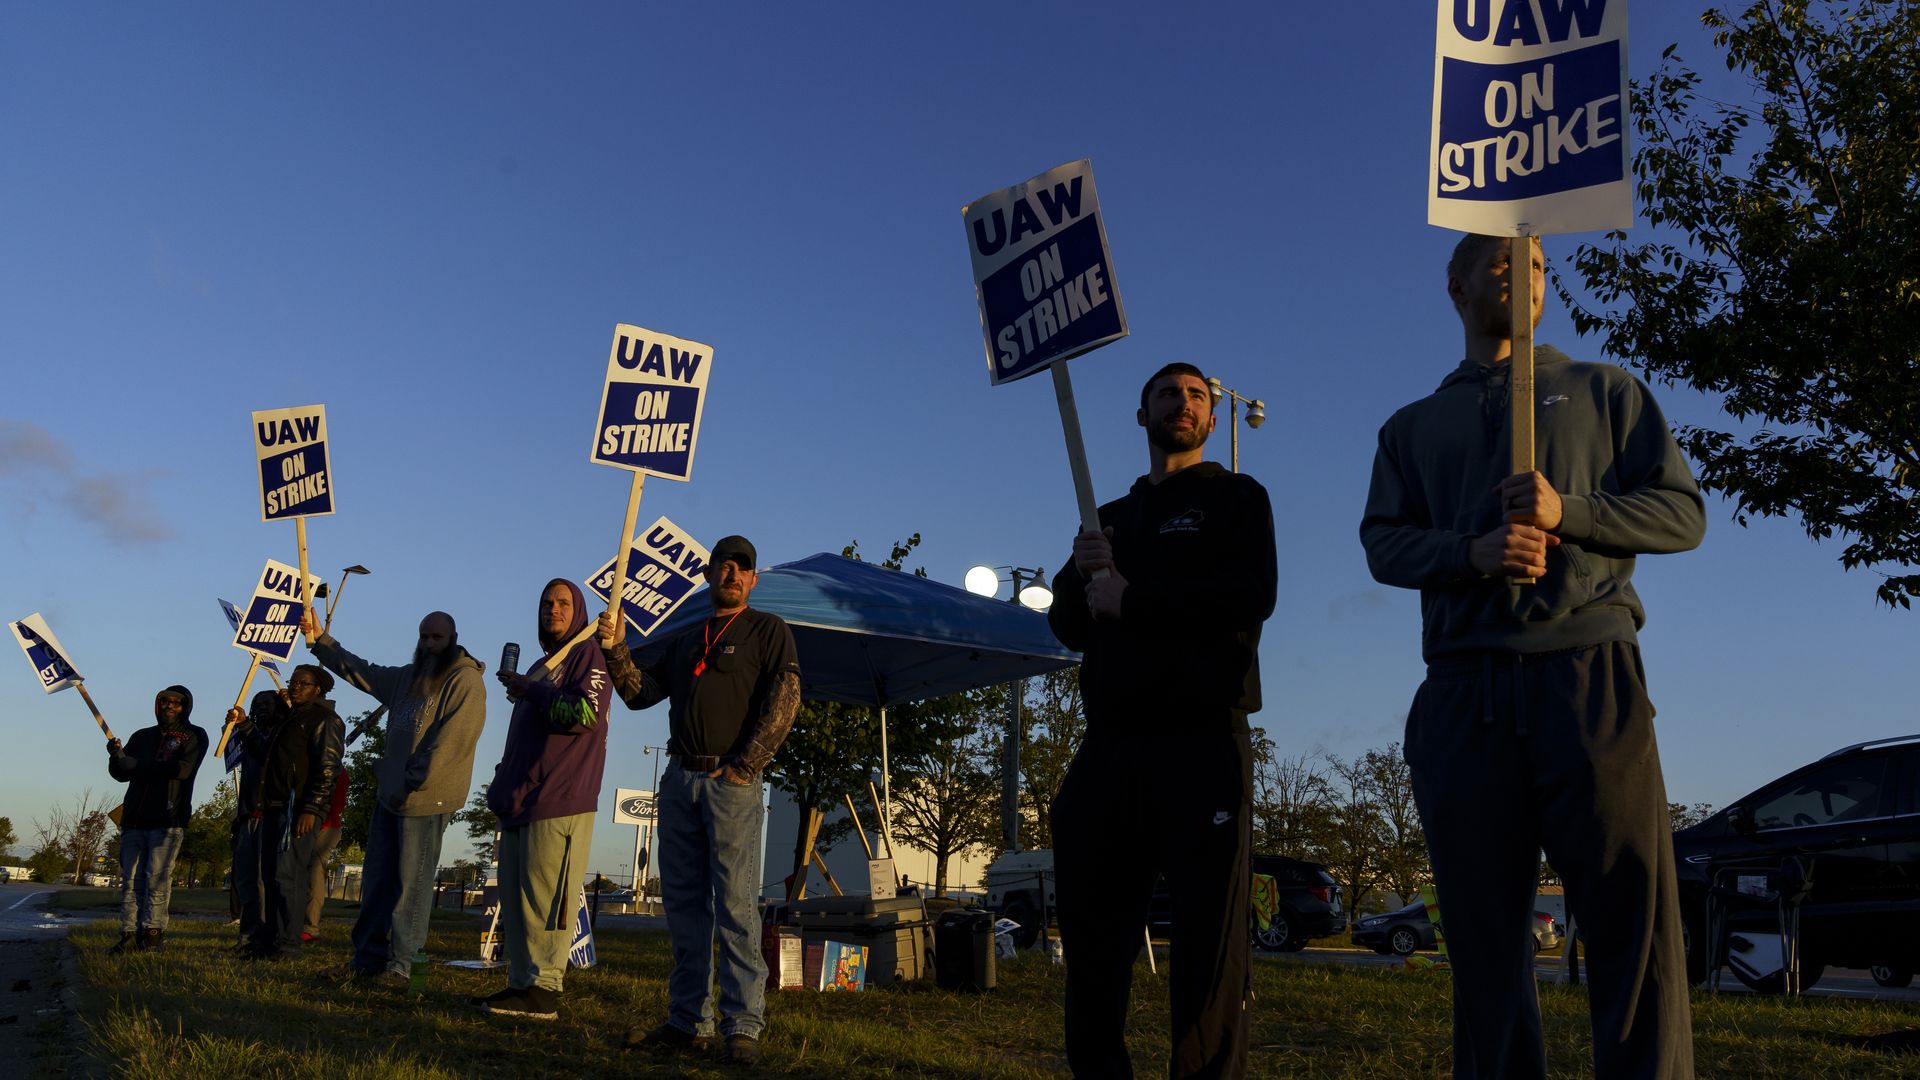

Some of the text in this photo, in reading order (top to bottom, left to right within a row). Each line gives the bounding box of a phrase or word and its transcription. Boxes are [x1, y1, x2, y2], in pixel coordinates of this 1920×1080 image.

[1453, 0, 1606, 46] UAW
[1484, 63, 1554, 128] ON
[1440, 94, 1620, 192] STRIKE
[973, 175, 1083, 257] UAW
[1020, 242, 1065, 302] ON
[997, 263, 1108, 369] STRIKE
[617, 335, 703, 384] UAW
[634, 390, 670, 421] ON
[258, 415, 320, 447] UAW
[601, 423, 690, 456] STRIKE
[281, 452, 305, 482] ON
[266, 470, 326, 515] STRIKE
[646, 525, 707, 578] UAW
[595, 570, 673, 617] SRIKE
[635, 563, 672, 588] ON
[240, 623, 297, 643] STRIKE
[265, 603, 290, 623] ON
